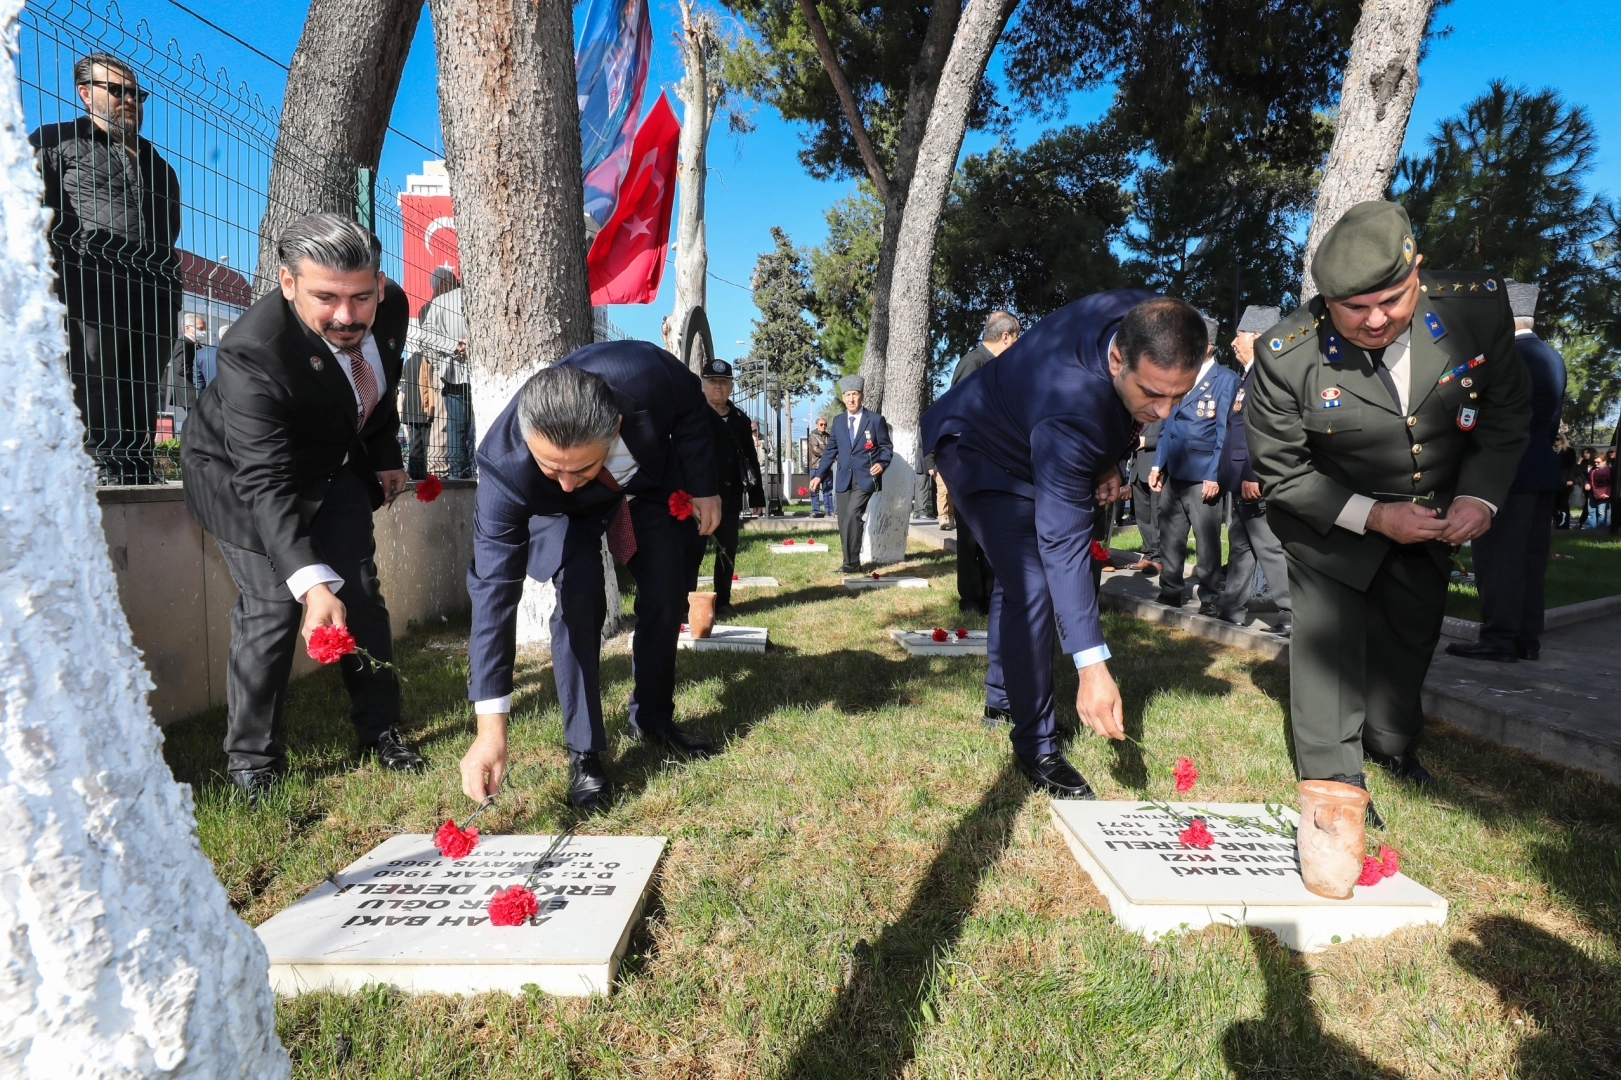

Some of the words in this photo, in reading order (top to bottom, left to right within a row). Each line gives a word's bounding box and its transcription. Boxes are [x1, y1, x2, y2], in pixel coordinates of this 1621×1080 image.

[1158, 853, 1217, 862] KIZI
[452, 860, 527, 868] MAYIS
[373, 870, 434, 878] 1960
[441, 870, 516, 879] OCAK
[1169, 866, 1242, 878] BAKİ
[333, 883, 477, 897] DERELİ
[356, 899, 450, 912] OĞLU
[340, 915, 431, 929] BAKİ
[437, 916, 553, 927] AAH
